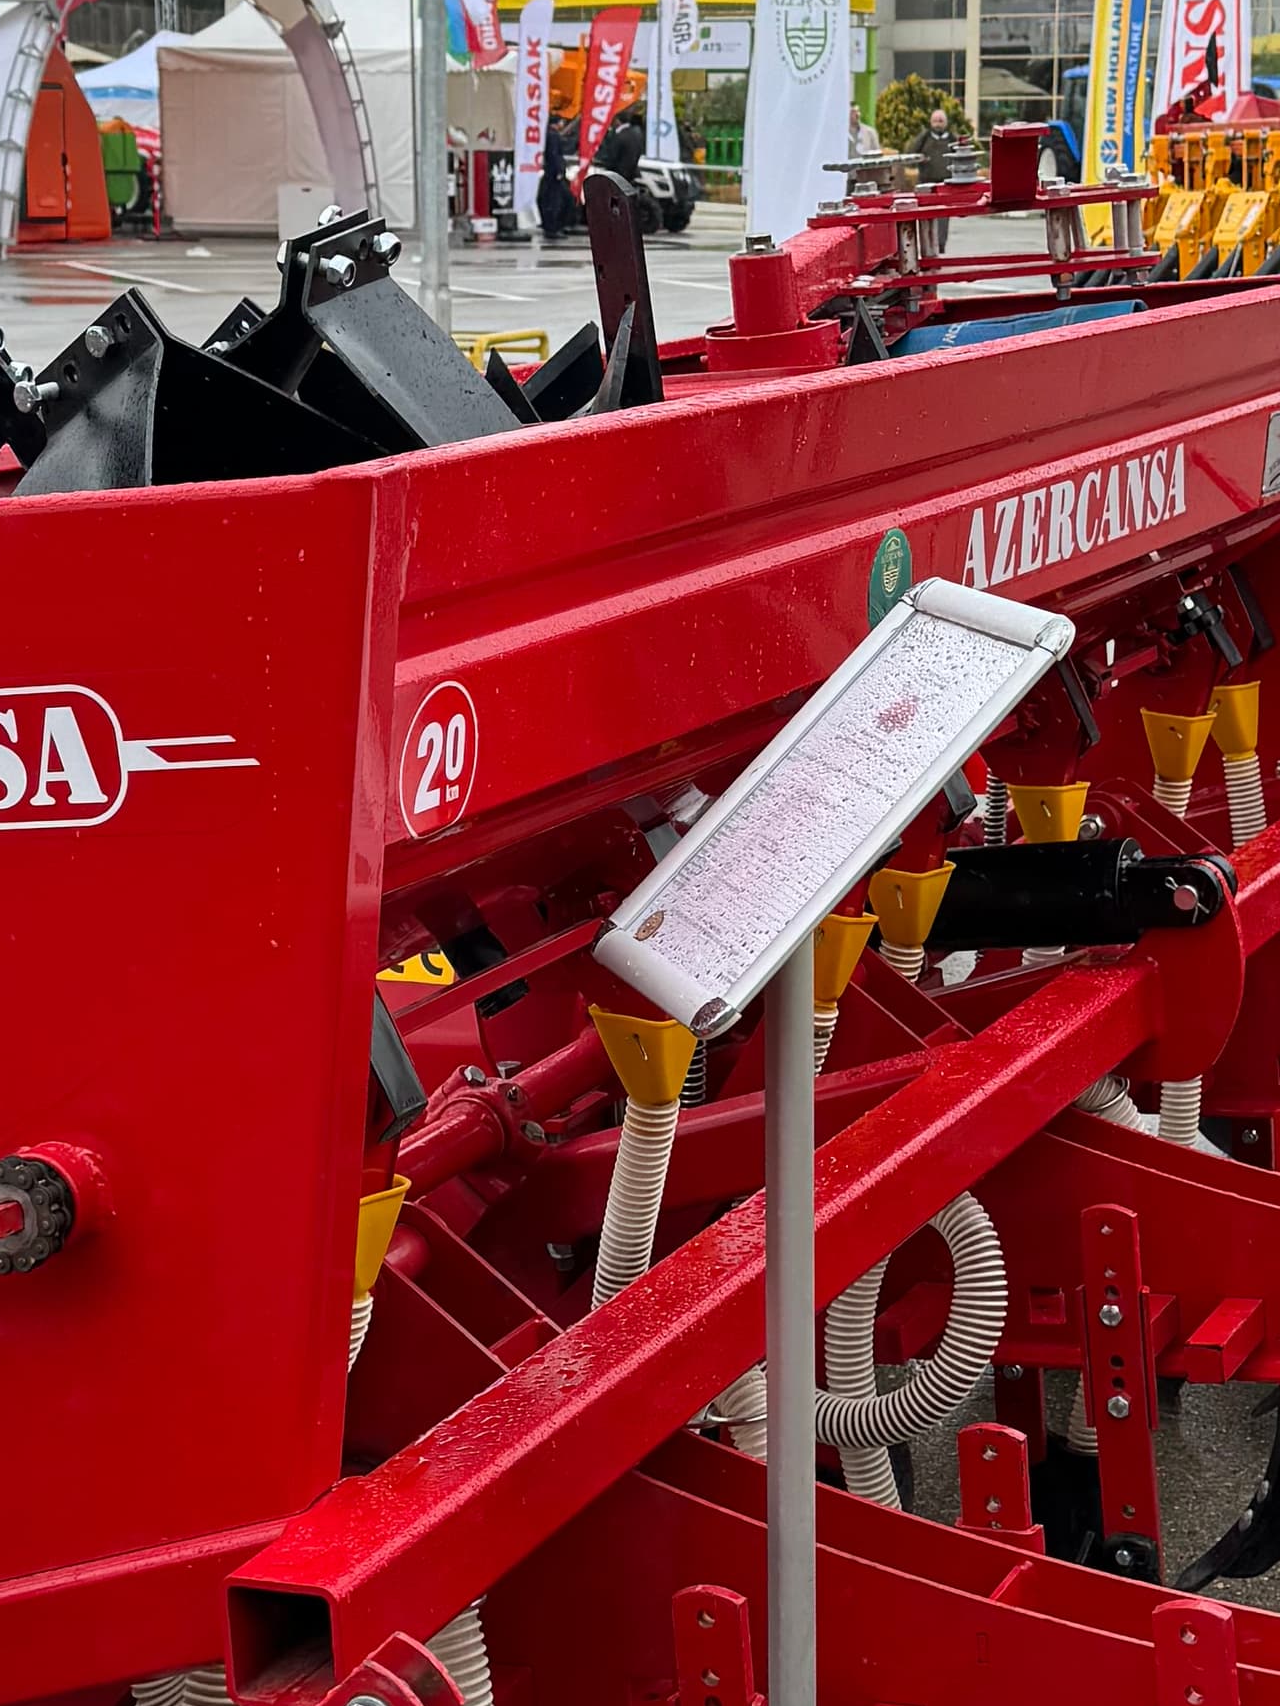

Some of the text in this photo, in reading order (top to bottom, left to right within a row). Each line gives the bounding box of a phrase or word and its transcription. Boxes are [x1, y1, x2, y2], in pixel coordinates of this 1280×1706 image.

[525, 35, 542, 144] BASAK
[1105, 87, 1118, 133] NEW
[1123, 20, 1143, 135] AGRICULTURE
[962, 442, 1186, 590] AZERCANSA
[414, 713, 466, 814] 20
